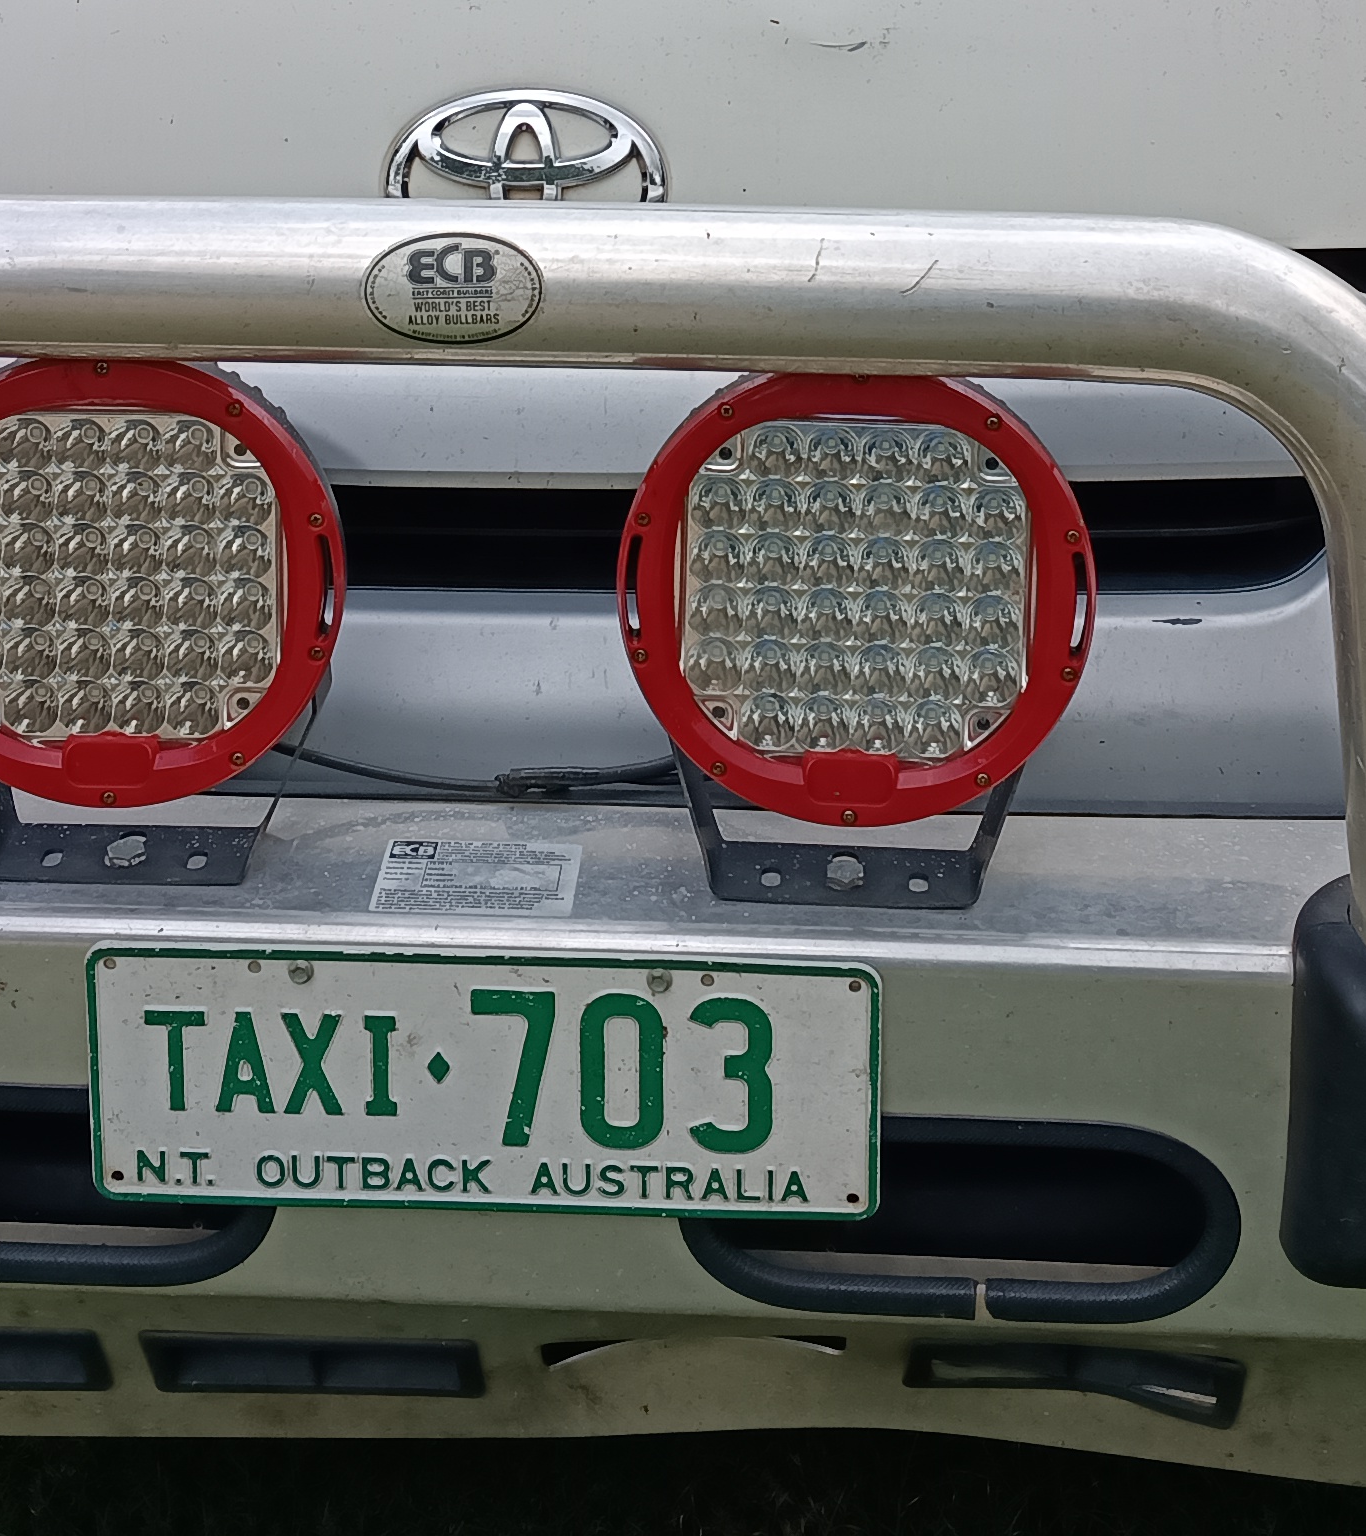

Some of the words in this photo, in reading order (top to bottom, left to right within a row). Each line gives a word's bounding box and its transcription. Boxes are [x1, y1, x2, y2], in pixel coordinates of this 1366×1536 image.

[406, 243, 497, 286] ECB
[412, 289, 430, 297] EAST
[431, 289, 455, 297] COAST
[456, 288, 493, 297] BULLBARS
[414, 300, 462, 313] WORLD'S
[465, 300, 491, 312] BEST
[408, 314, 440, 326] ALLOY
[444, 312, 500, 325] BULLBARS
[143, 1009, 399, 1117] TAXI
[469, 988, 774, 1155] 703
[135, 1150, 215, 1187] N.T.
[256, 1154, 492, 1194] OUTBACK
[531, 1163, 810, 1204] AUSTRALIA
